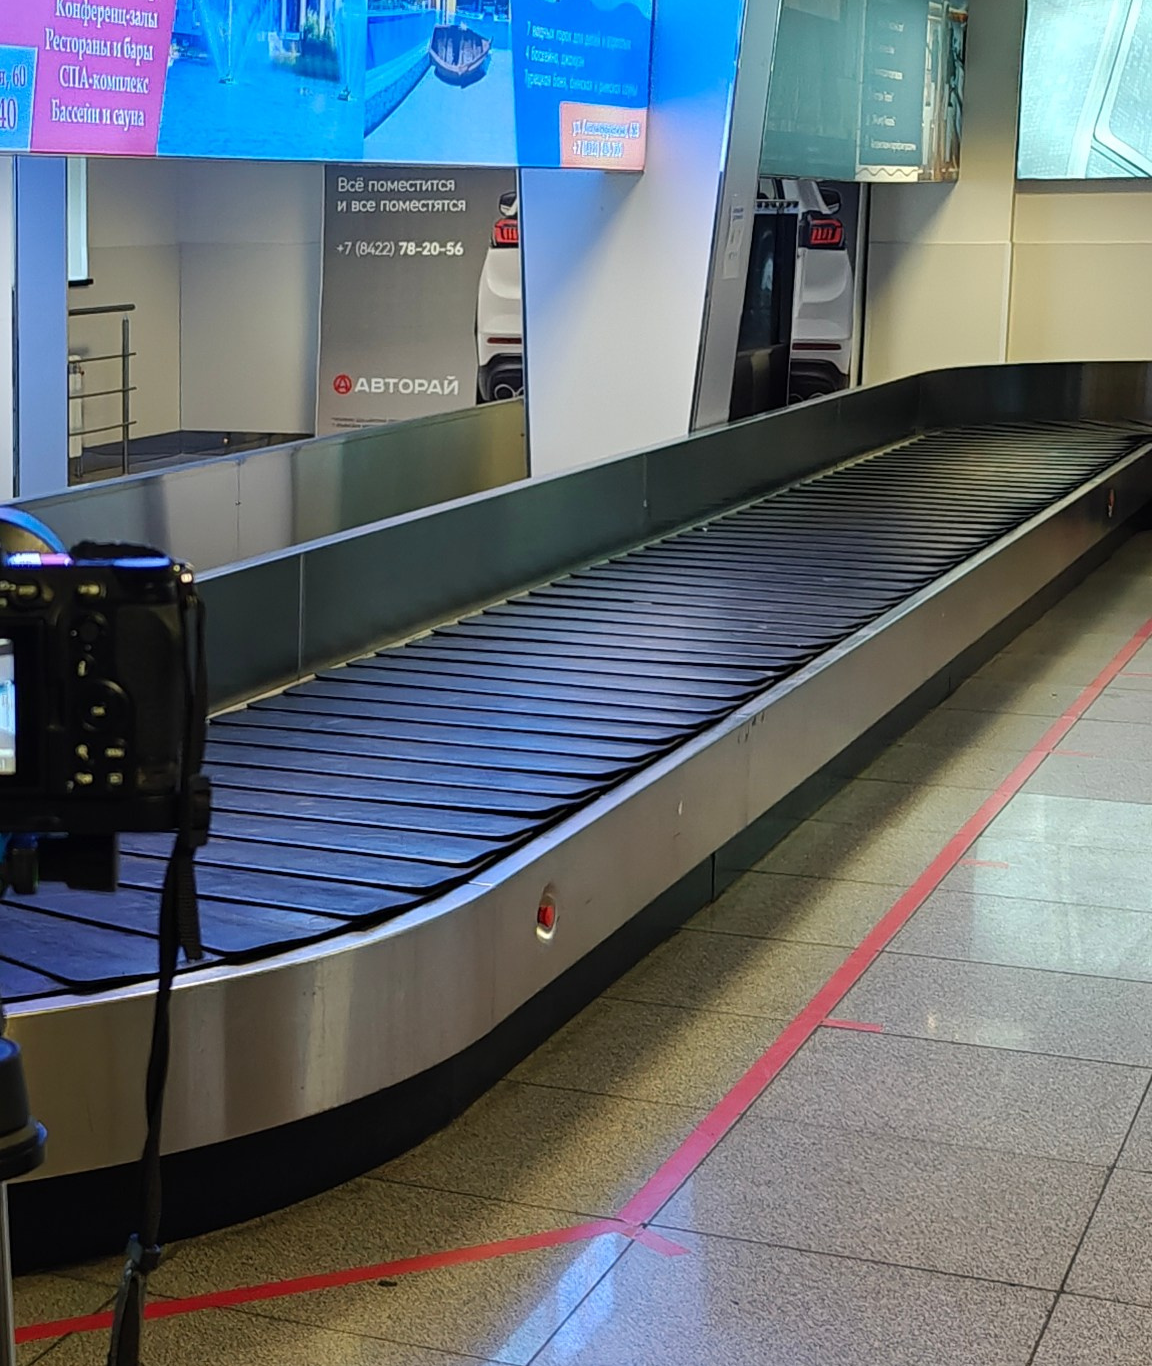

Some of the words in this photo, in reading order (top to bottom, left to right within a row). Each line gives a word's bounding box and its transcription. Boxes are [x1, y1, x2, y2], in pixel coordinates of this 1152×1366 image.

[45, 28, 110, 60] Рестораны
[113, 43, 121, 57] и
[124, 38, 153, 65] бары
[12, 65, 27, 86] 60
[60, 65, 149, 94] СПА-комплекс
[51, 99, 100, 124] Бассейн
[102, 108, 110, 124] и
[113, 109, 144, 131] сауна
[338, 177, 364, 192] Всё
[368, 179, 455, 192] поместится
[337, 200, 346, 212] и
[352, 200, 376, 212] все
[380, 199, 466, 212] поместятся
[336, 242, 351, 255] +7
[355, 241, 395, 257] (8422)
[399, 241, 464, 256] 78-20-56
[354, 376, 459, 395] АВТОРАЙ
